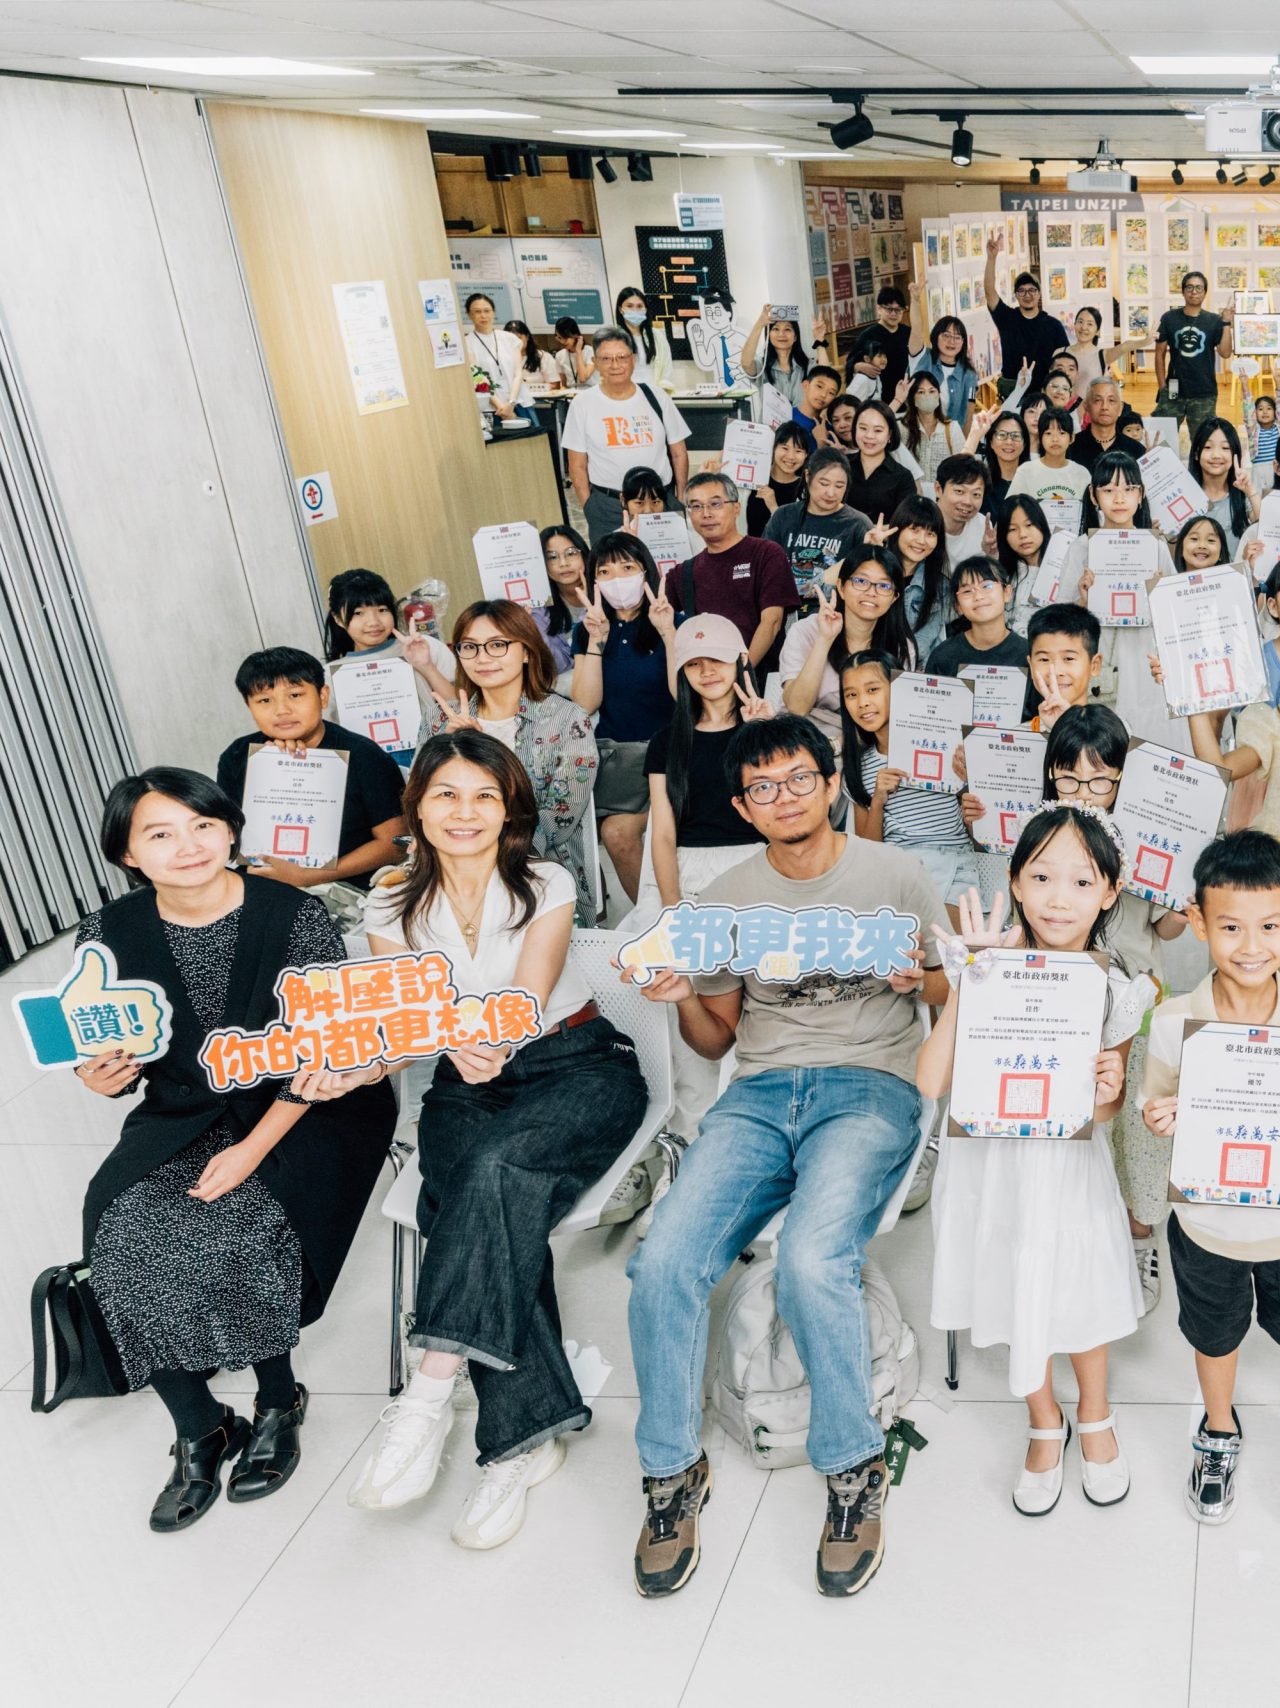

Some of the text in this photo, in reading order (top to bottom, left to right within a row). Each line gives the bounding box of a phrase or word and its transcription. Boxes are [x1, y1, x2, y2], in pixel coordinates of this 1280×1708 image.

[1010, 199, 1128, 211] TAIPEI UNZIP
[817, 537, 842, 554] FUN
[668, 902, 917, 975] 都更我來
[282, 954, 456, 1024] 解壓說
[1002, 969, 1070, 983] 臺北市政府獎狀
[70, 1002, 146, 1047] 讚!
[206, 990, 541, 1088] 你的都更想像
